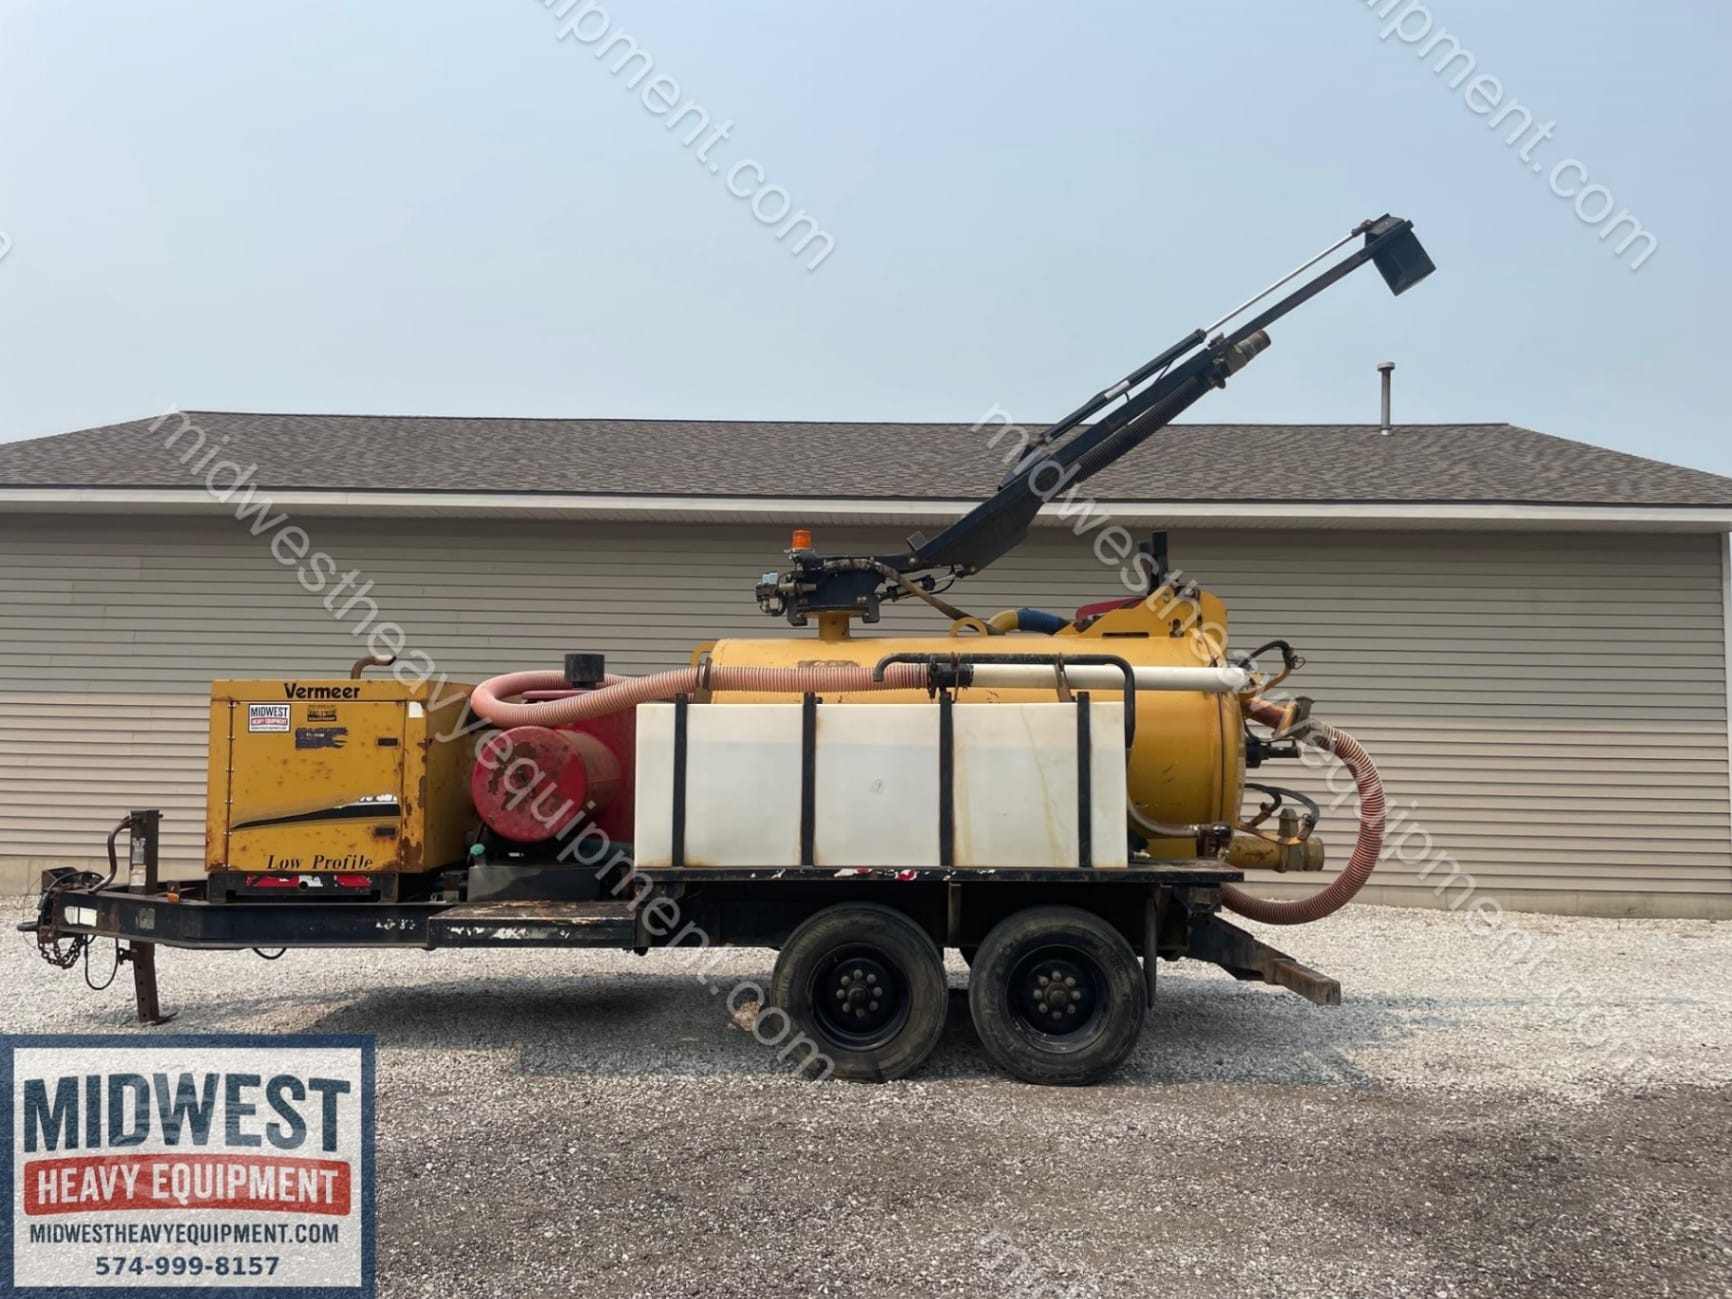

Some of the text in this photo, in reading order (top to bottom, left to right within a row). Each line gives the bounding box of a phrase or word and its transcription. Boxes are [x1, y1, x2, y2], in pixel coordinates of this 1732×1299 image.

[284, 682, 360, 699] Vermeer
[251, 706, 288, 717] MIDWEST
[267, 854, 373, 870] Low Profile
